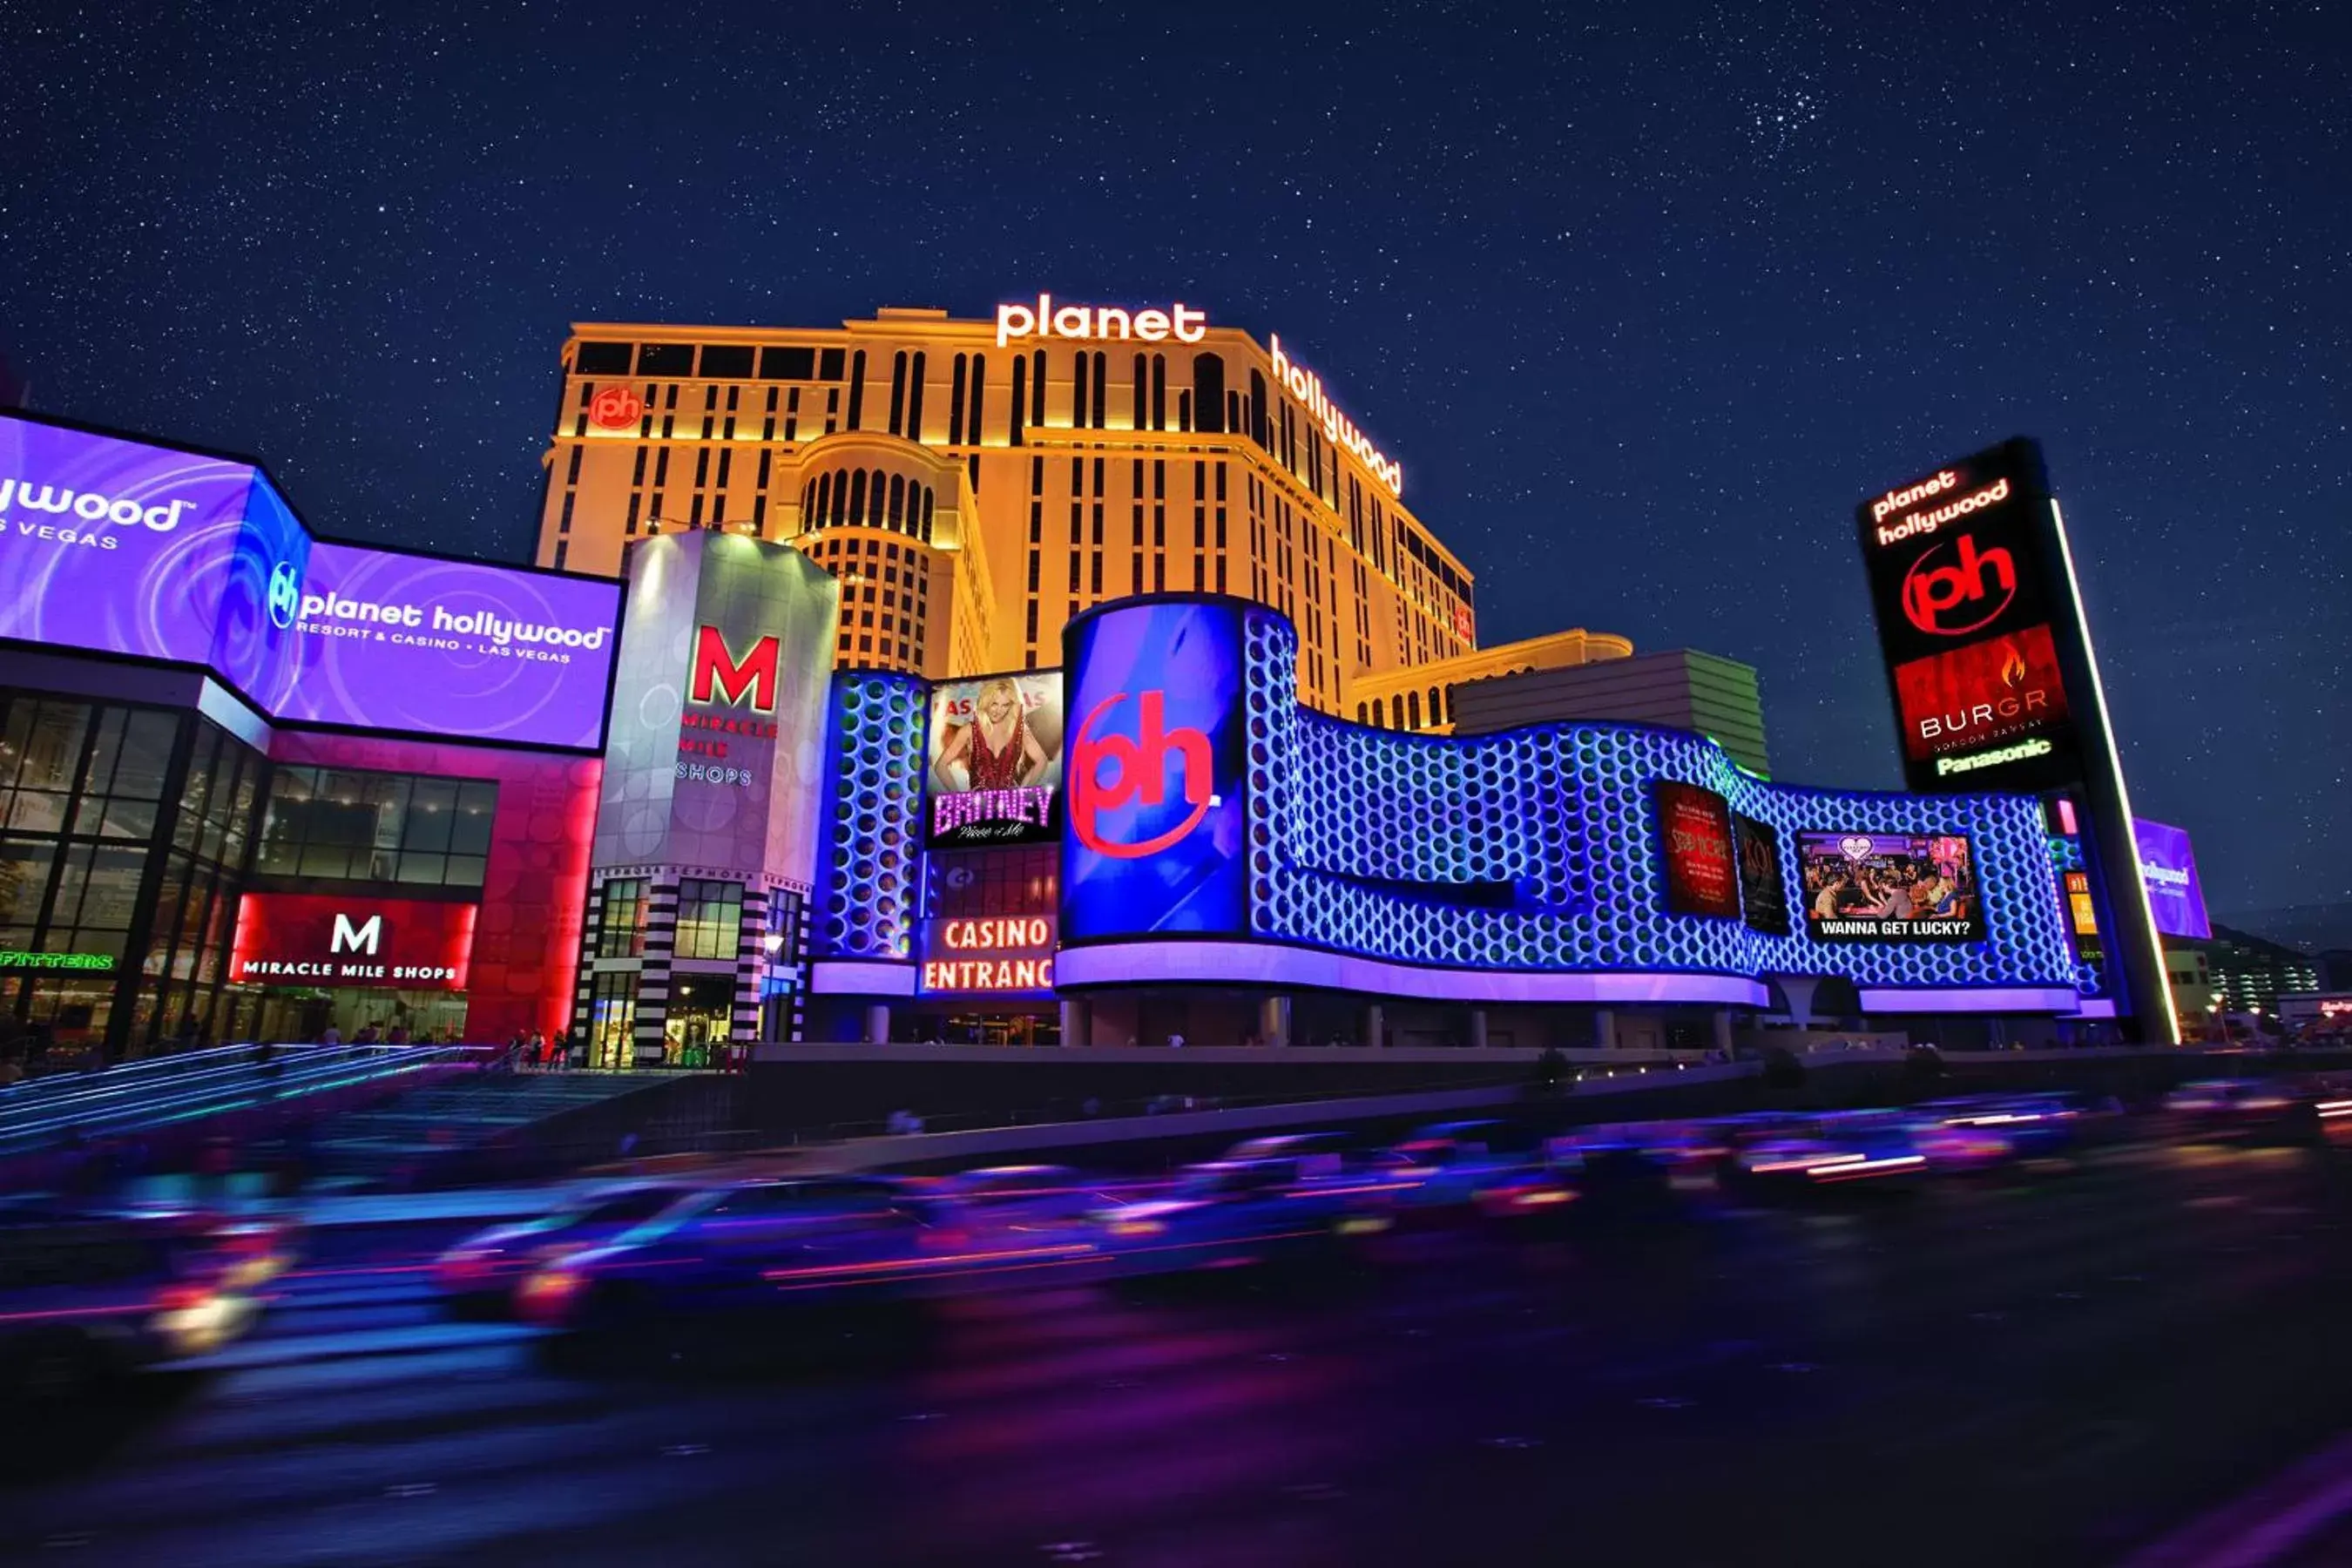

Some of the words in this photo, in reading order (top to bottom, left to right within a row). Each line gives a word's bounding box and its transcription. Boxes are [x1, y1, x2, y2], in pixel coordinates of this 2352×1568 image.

[996, 294, 1206, 348] planet
[596, 389, 639, 424] ph
[1270, 332, 1402, 495] hollywood
[1873, 470, 1957, 522] planet
[1877, 477, 2010, 545] hollywood
[17, 521, 118, 550] VEGAS
[1907, 534, 2017, 633] ph
[299, 591, 423, 627] planet
[432, 605, 603, 650] hollywood
[295, 621, 372, 641] RESORT
[389, 633, 460, 650] CASINO
[478, 645, 510, 656] LAS
[515, 649, 571, 664] VEGAS
[690, 625, 781, 713] M
[679, 713, 779, 739] MIRACLE
[1920, 690, 2047, 739] BURGR
[679, 738, 729, 758] MILE
[1936, 739, 2052, 775] Panasonic
[674, 761, 752, 786] SHOPS
[1071, 690, 1213, 853] ph
[934, 785, 1055, 837] BRITNEY
[671, 865, 754, 881] SEPHORA
[764, 874, 811, 895] SEPHORA
[330, 913, 382, 956] M
[944, 918, 1048, 949] CASINO
[1821, 921, 1877, 936] WANNA
[1882, 921, 1909, 936] GET
[1913, 921, 1971, 936] LUCKY?
[242, 961, 333, 977] MIRACLE
[341, 964, 386, 978] MILE
[393, 966, 457, 980] SHOPS
